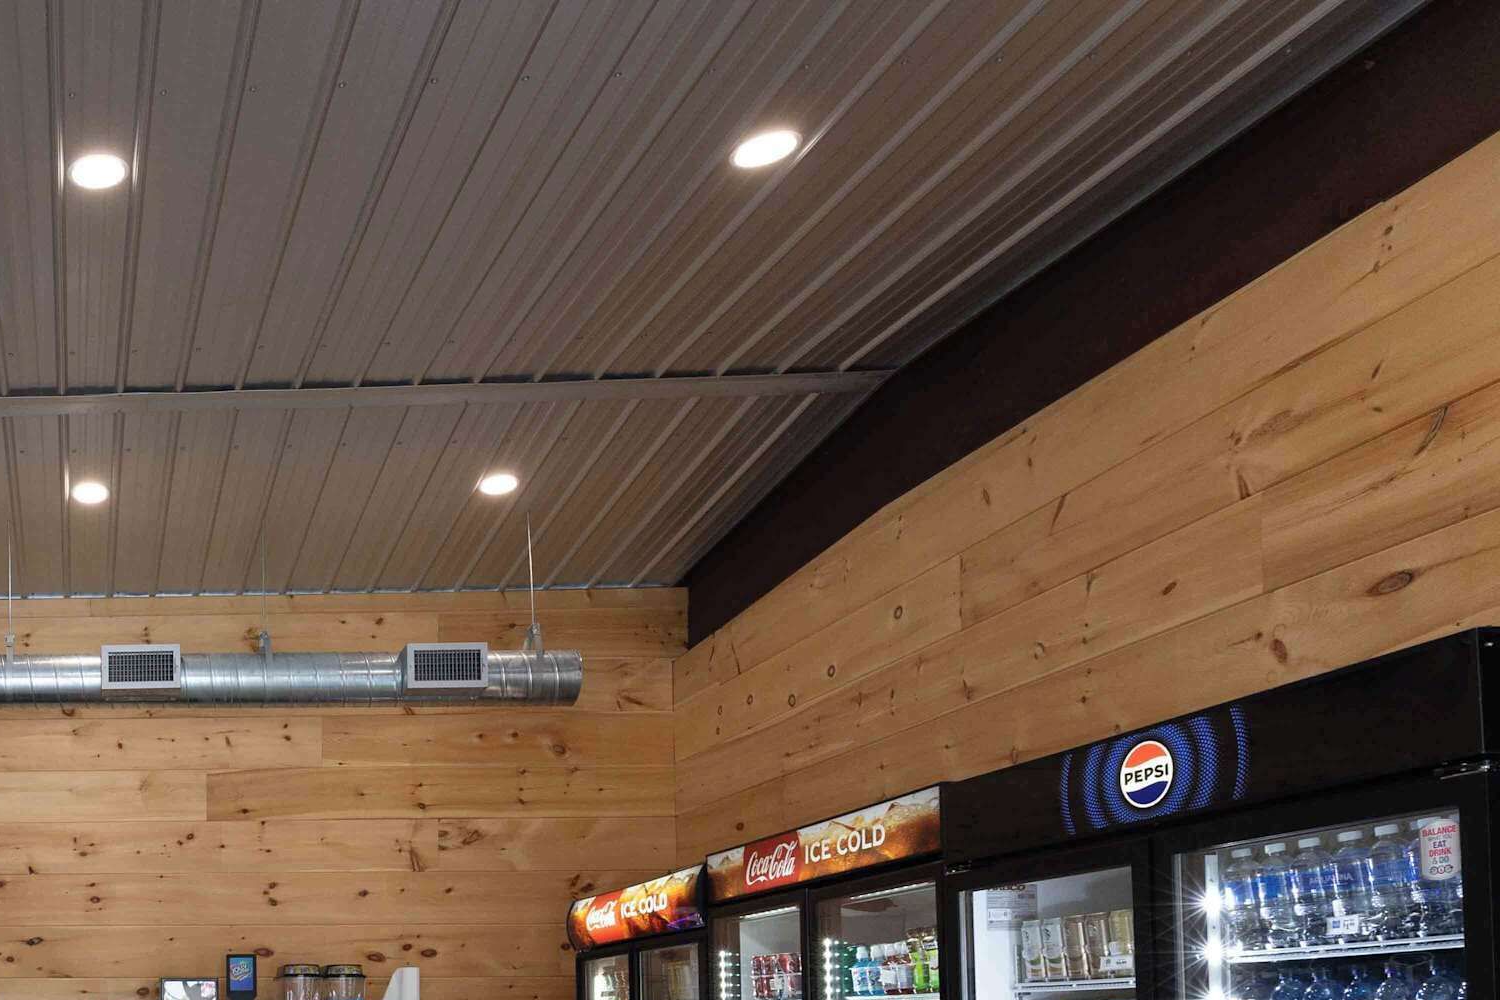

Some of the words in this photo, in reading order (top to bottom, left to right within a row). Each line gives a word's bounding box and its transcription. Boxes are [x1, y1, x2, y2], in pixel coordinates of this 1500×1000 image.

[1124, 763, 1169, 786] PEPSI
[1422, 824, 1457, 838] BALANCE
[1428, 848, 1452, 858] DRINK
[1433, 840, 1446, 849] EAT
[745, 840, 799, 885] Coca-Cola
[804, 840, 832, 865] ICE
[836, 823, 886, 856] COLD
[620, 900, 638, 919] ICE
[638, 892, 668, 915] COLD
